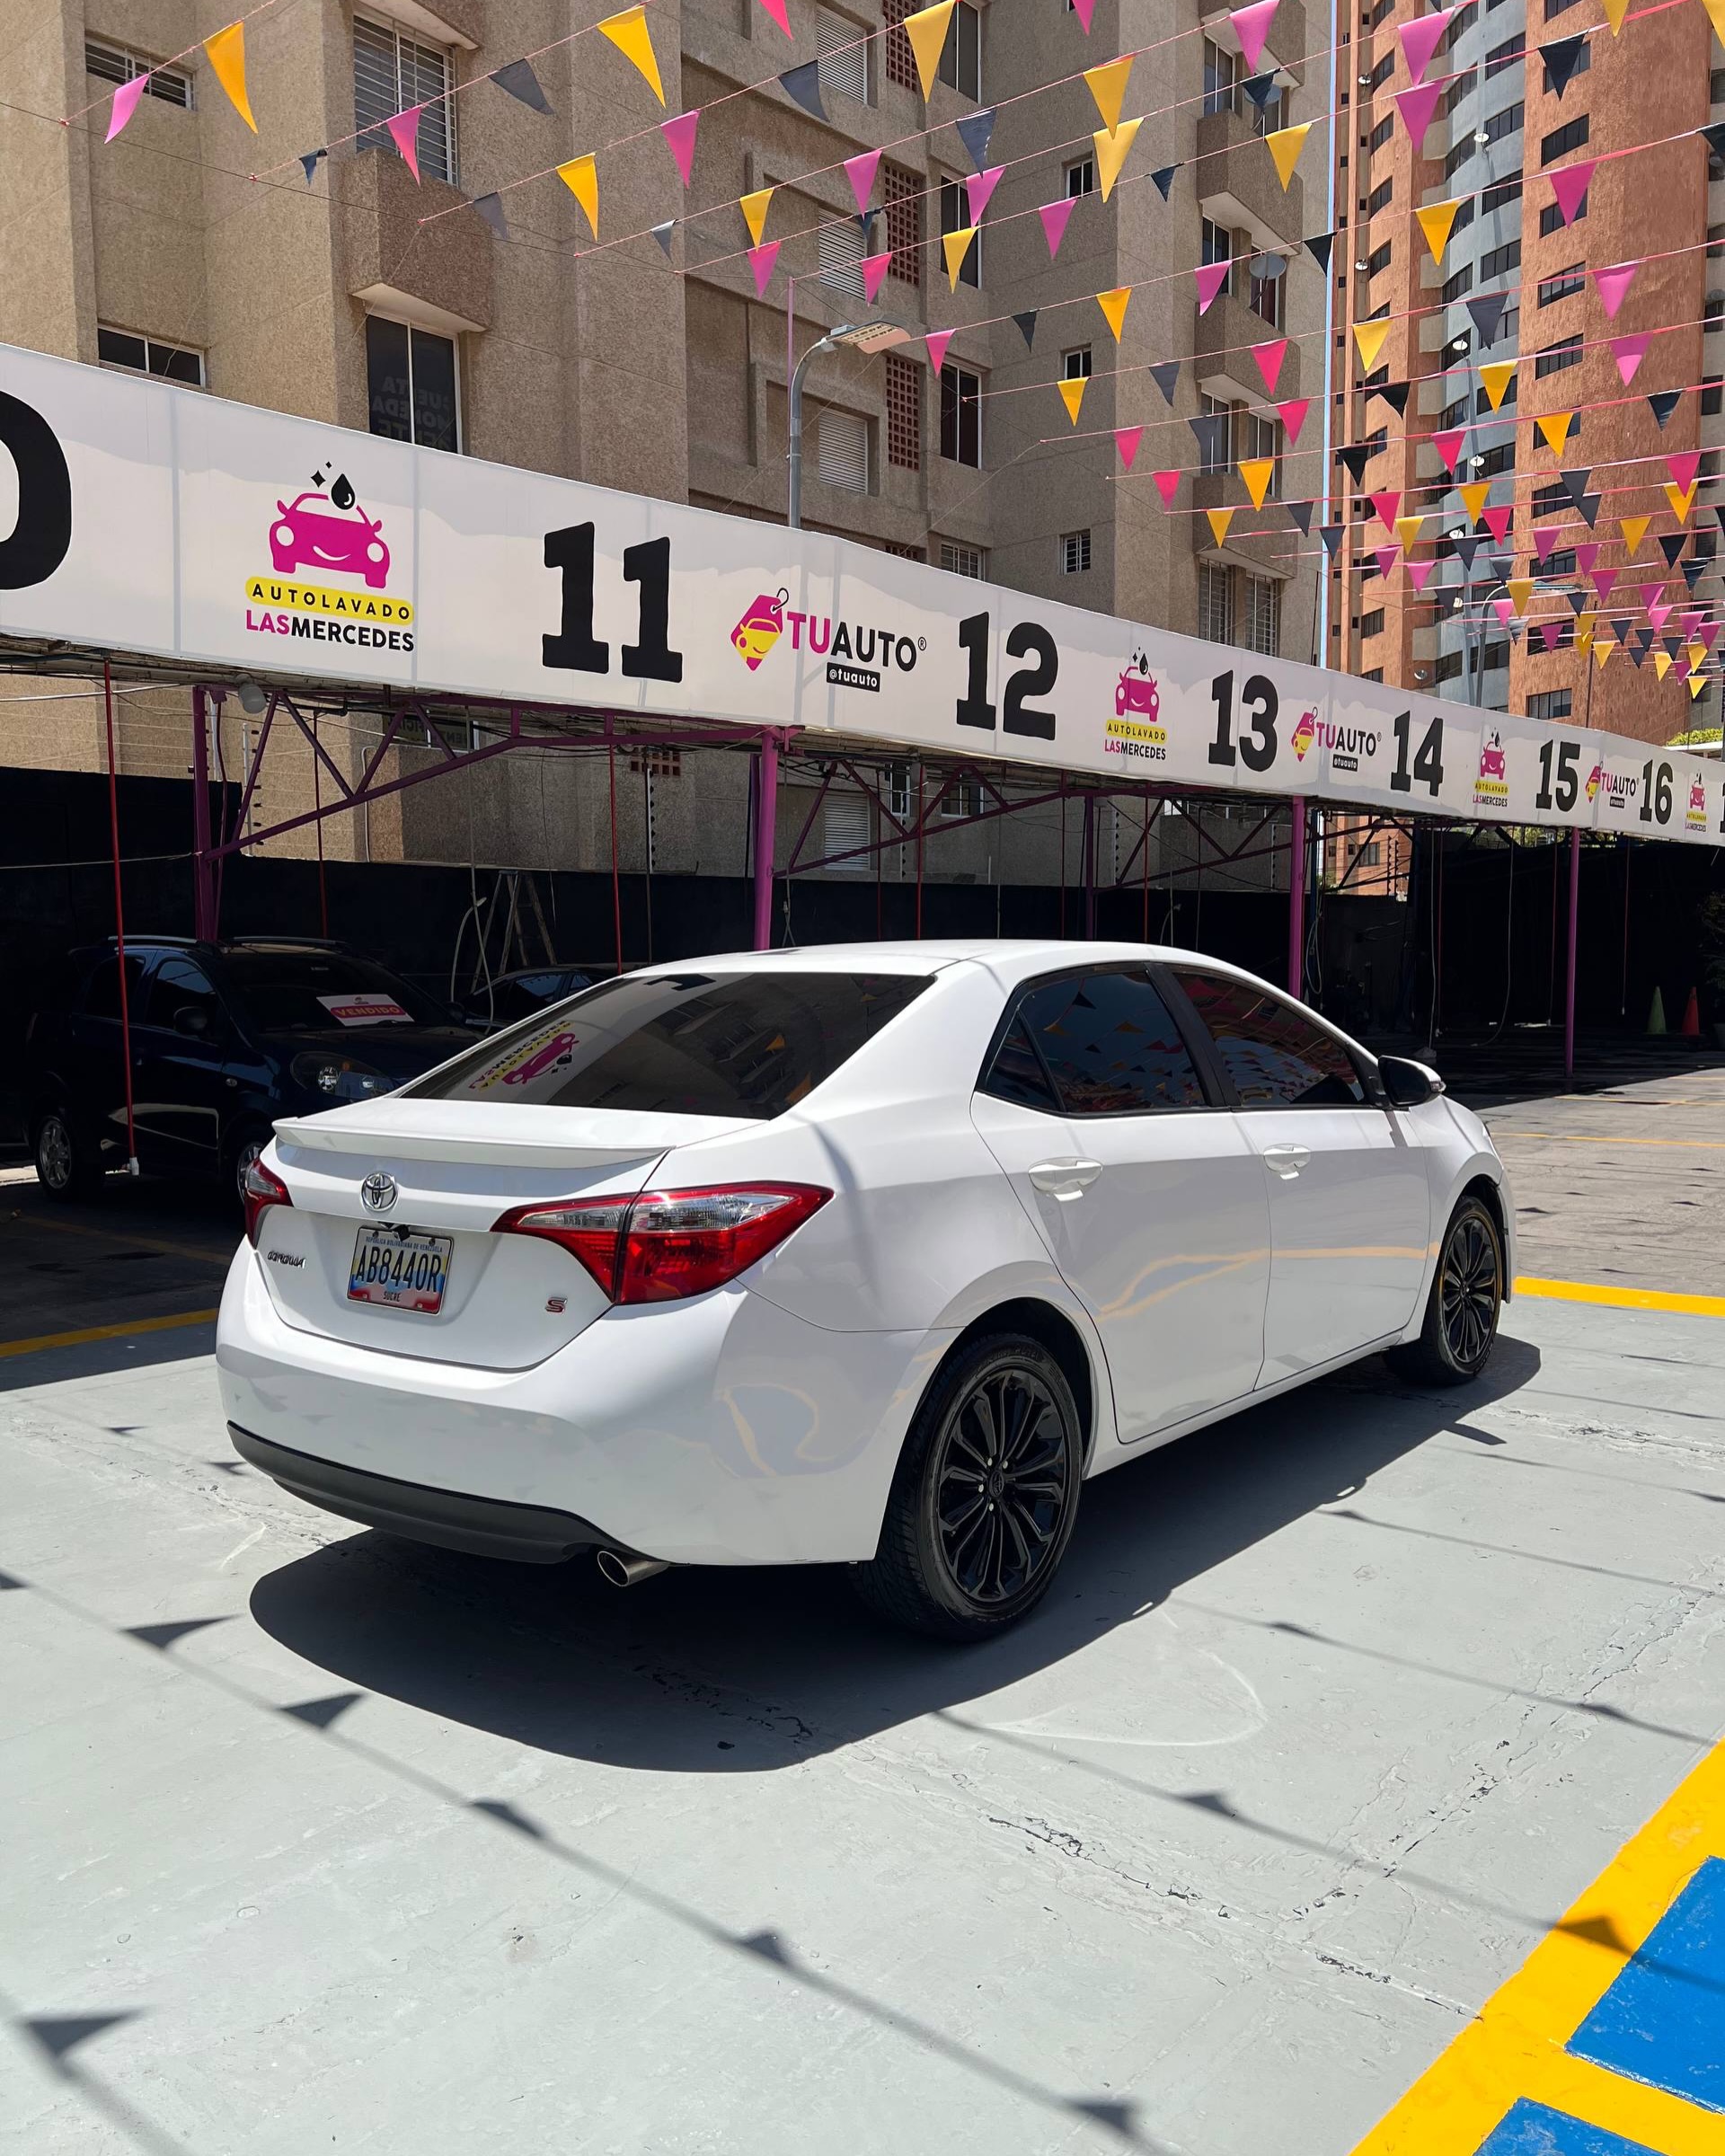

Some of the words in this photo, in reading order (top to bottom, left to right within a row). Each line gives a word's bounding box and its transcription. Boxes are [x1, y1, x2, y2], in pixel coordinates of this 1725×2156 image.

[252, 583, 411, 620] AUTOLAVADO
[542, 521, 683, 684] 11
[246, 610, 414, 652] LASMERCEDES
[829, 667, 878, 687] @tuauto
[956, 612, 1058, 741] 12
[1108, 722, 1165, 741] AUTOLAVADO
[1208, 670, 1278, 772] 13
[1104, 739, 1166, 760] LASMERCEDES
[1390, 710, 1444, 797] 14
[1535, 739, 1580, 812] 15
[1640, 759, 1674, 825] 16
[1473, 794, 1508, 807] LASMERCEDES
[336, 1006, 402, 1017] VENDIDO
[383, 1291, 401, 1303] SUCRE
[545, 1296, 568, 1313] S
